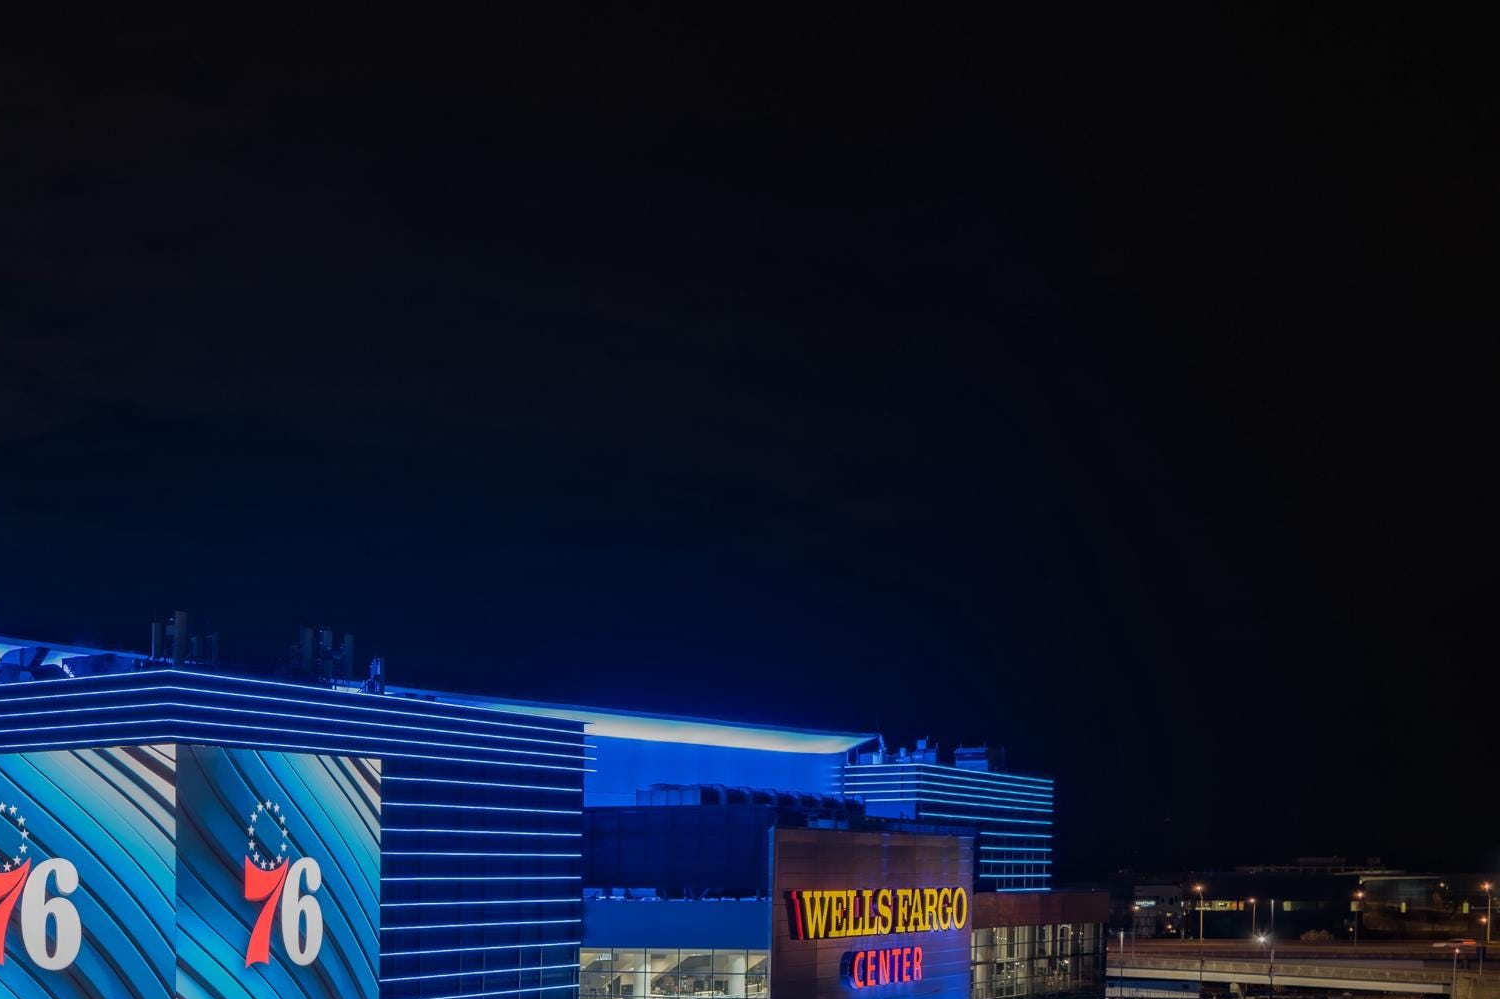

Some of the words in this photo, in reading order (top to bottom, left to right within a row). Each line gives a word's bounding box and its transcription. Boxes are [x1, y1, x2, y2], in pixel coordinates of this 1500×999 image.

[244, 856, 324, 969] 76
[801, 887, 893, 940] WELLS
[895, 886, 968, 934] FARGO
[852, 946, 924, 990] CENTER
